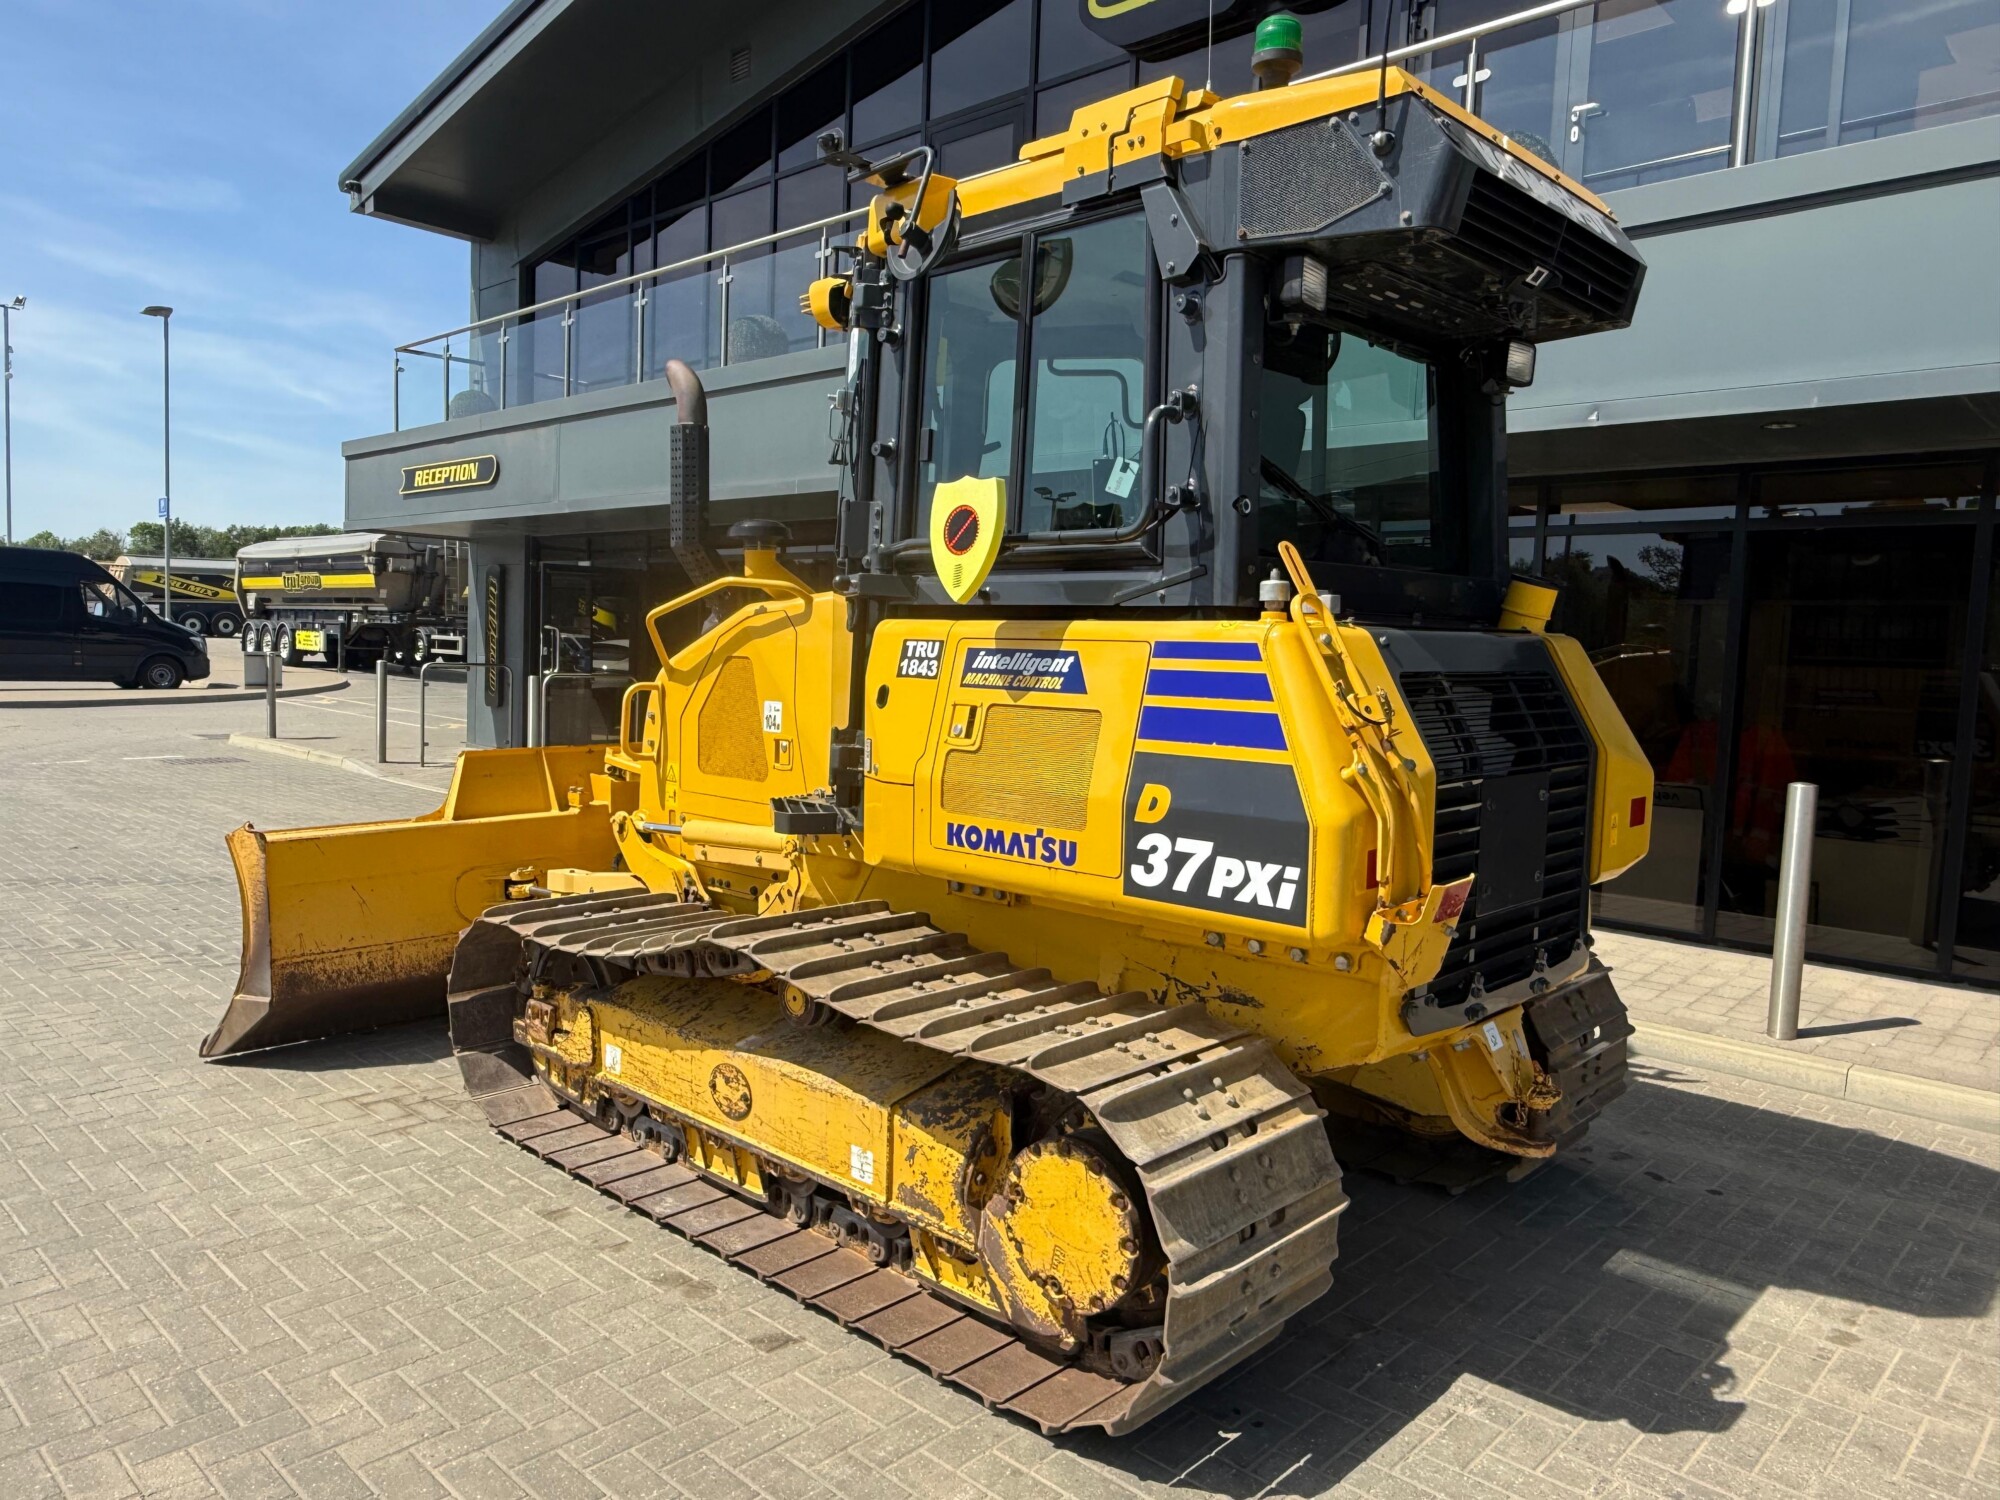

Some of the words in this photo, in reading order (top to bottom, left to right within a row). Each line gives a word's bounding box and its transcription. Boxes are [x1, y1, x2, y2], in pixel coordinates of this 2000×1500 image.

[414, 462, 479, 487] RECEPTION
[905, 640, 940, 659] TRU
[899, 658, 938, 677] 1843
[971, 650, 1076, 677] intelligent
[962, 672, 1011, 688] MACHINE
[1012, 674, 1064, 690] CONTROL
[1134, 783, 1172, 824] D
[946, 822, 1077, 867] KOMATSU
